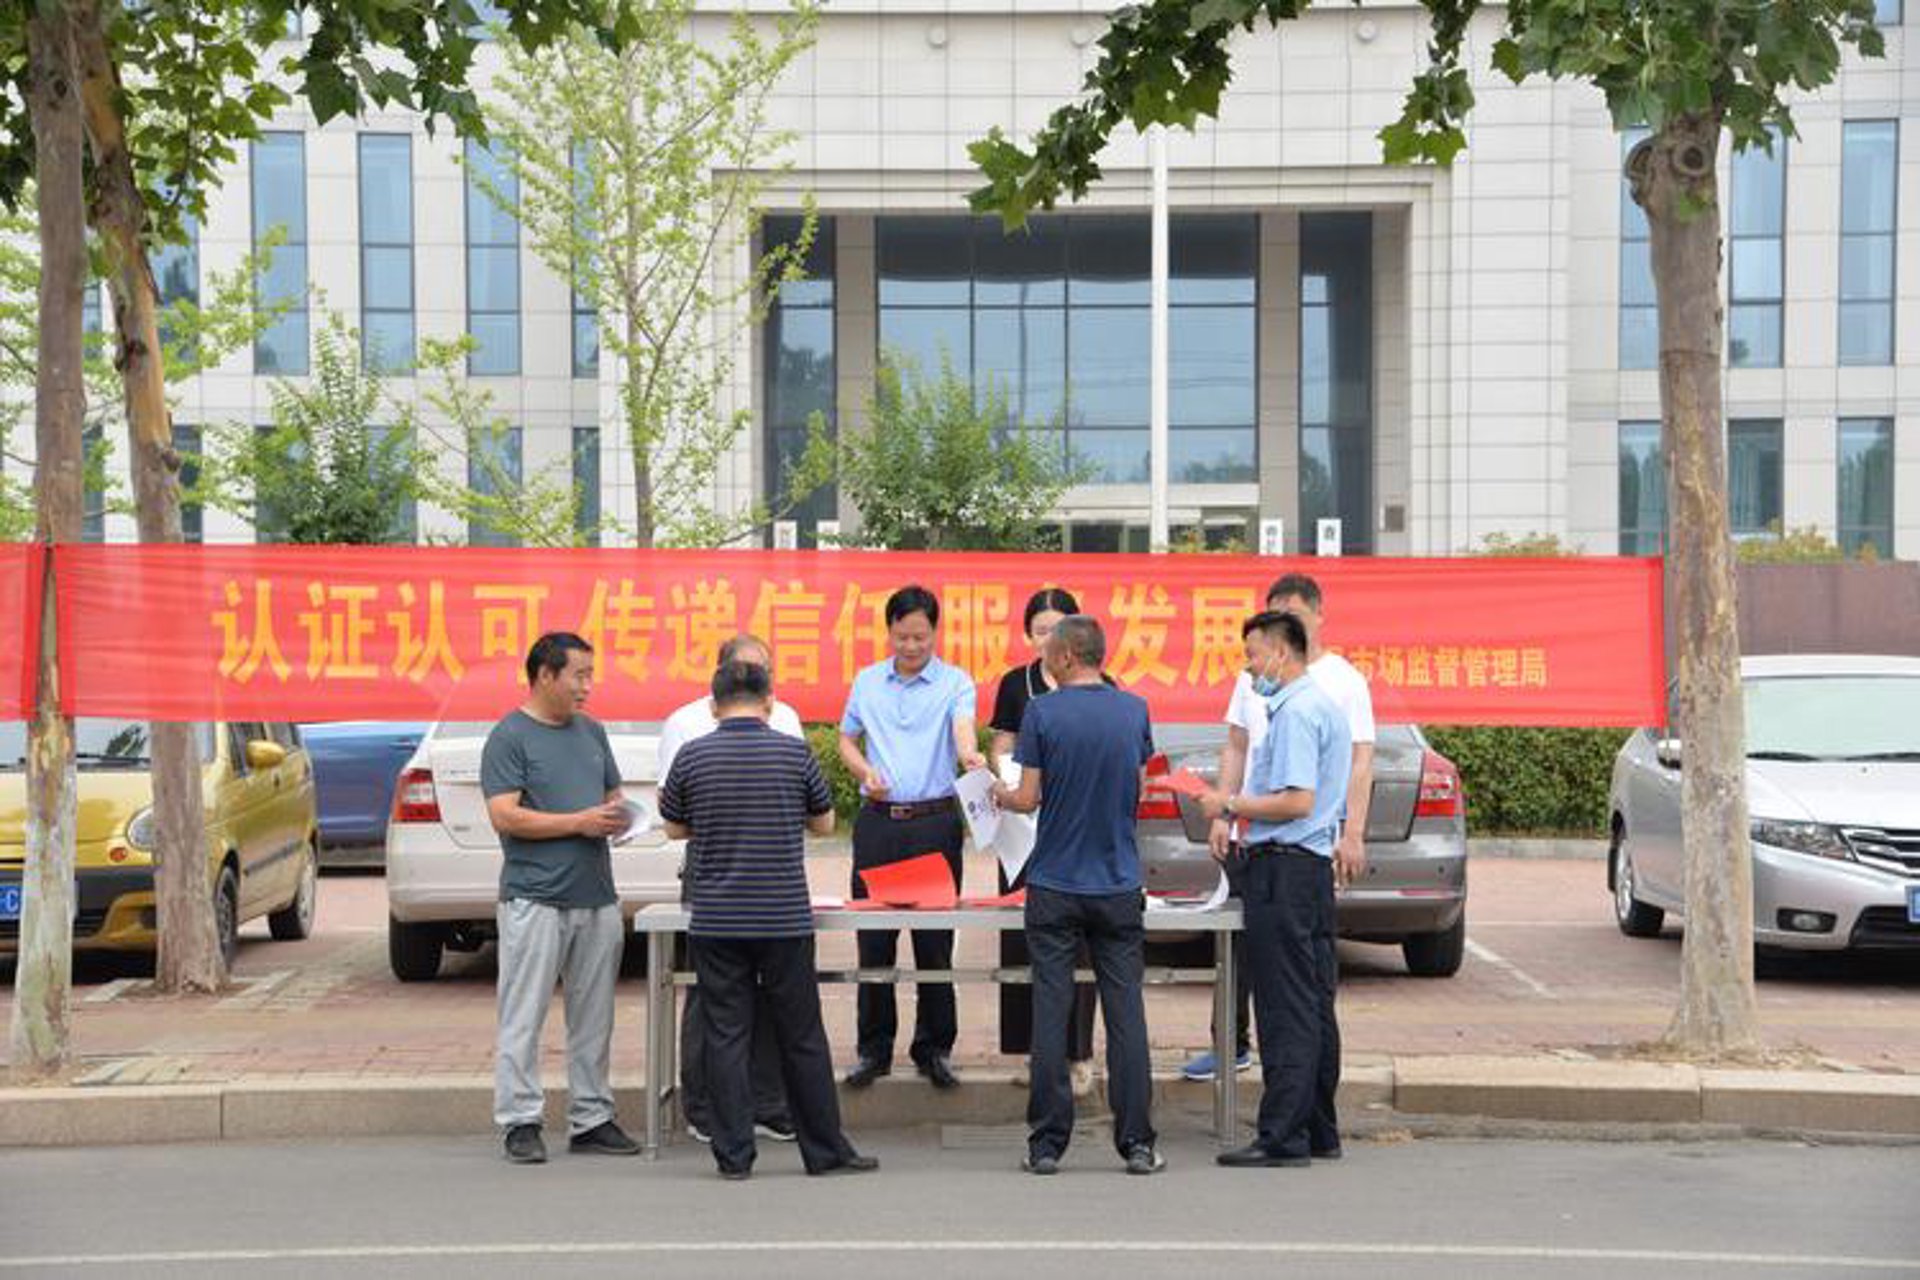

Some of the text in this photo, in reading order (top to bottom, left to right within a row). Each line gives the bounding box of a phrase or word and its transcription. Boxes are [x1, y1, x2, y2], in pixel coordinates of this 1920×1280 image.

[211, 577, 1257, 687] 认证认可 传递信任 服发展
[1329, 645, 1547, 687] 市场监督管理局
